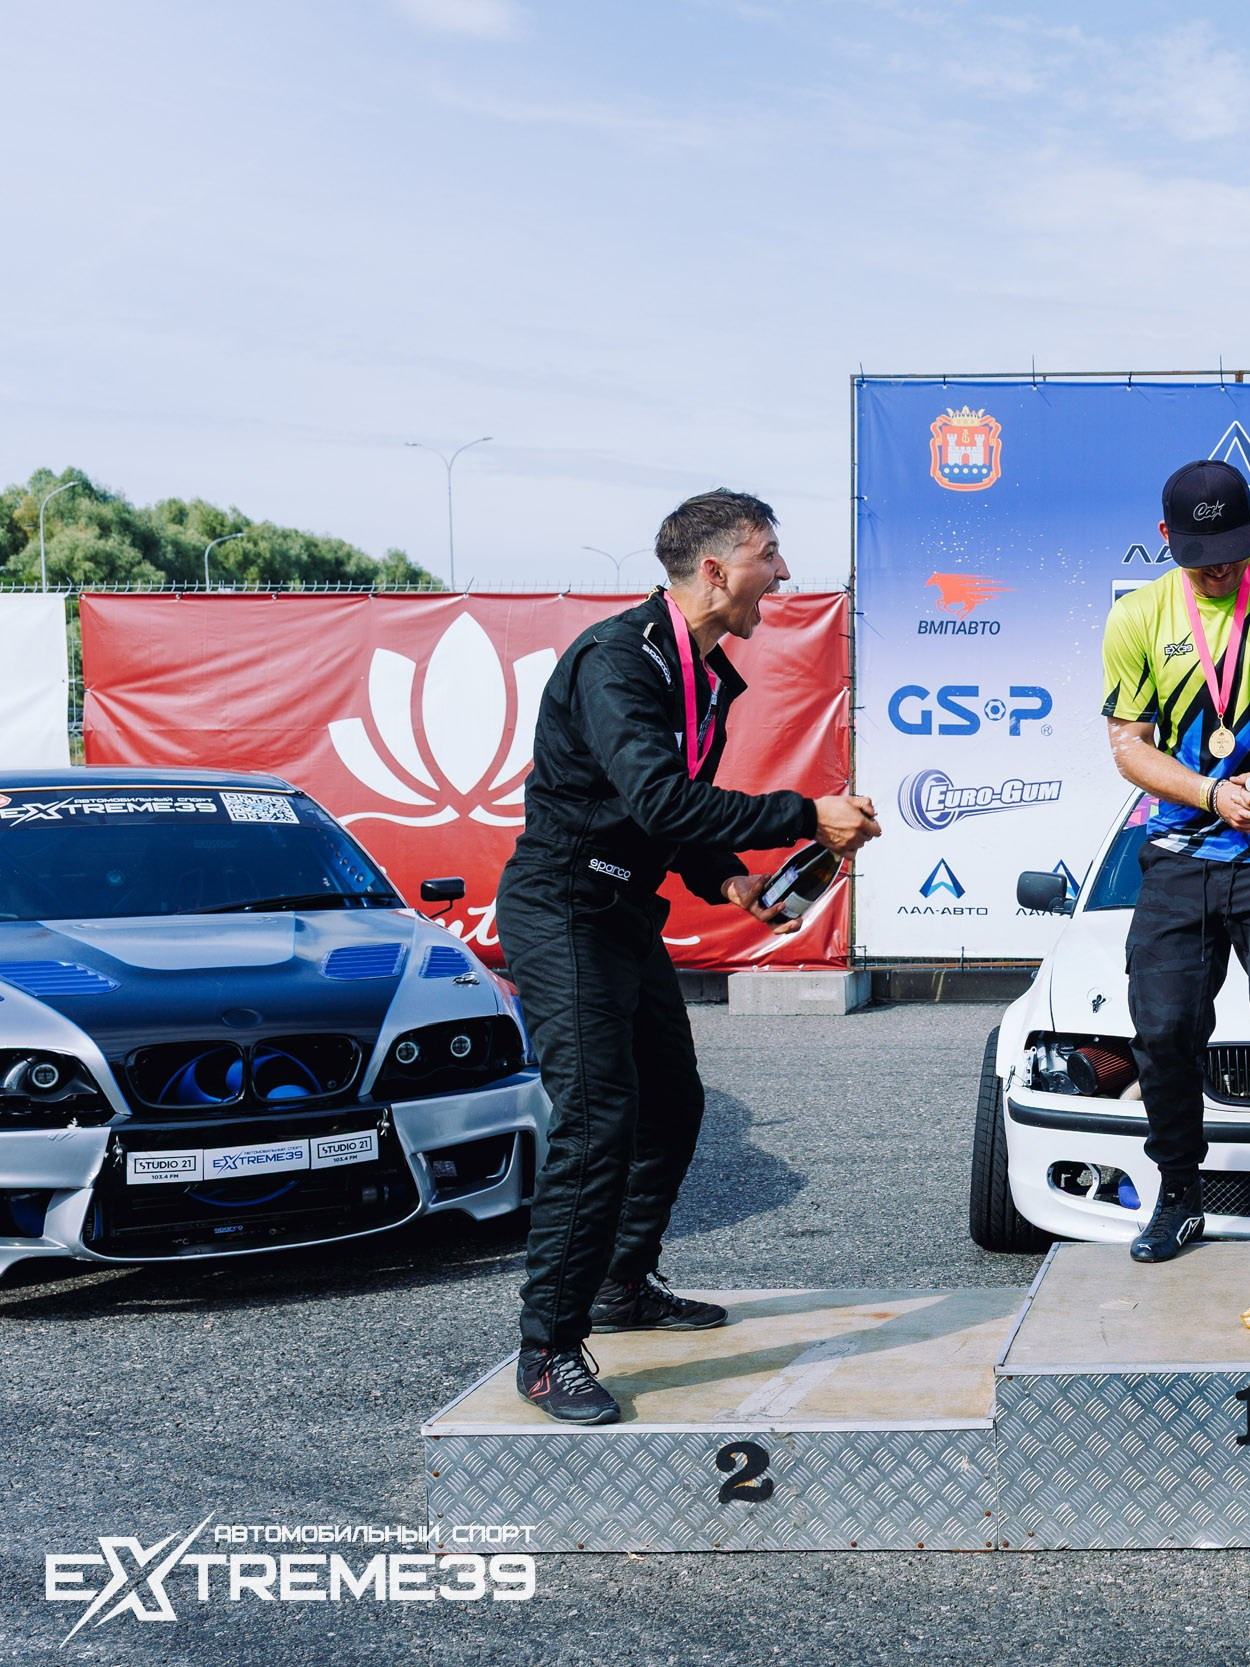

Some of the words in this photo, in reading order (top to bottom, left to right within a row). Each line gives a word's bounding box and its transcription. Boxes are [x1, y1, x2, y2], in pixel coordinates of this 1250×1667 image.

[917, 620, 1001, 636] ВМПАВТО
[588, 858, 631, 881] sparco
[322, 1143, 356, 1154] STUDIO
[358, 1140, 368, 1149] 21
[139, 1159, 179, 1170] STUDIO
[181, 1159, 192, 1169] 21
[212, 1150, 303, 1174] EXTREME39
[715, 1441, 774, 1504] 2
